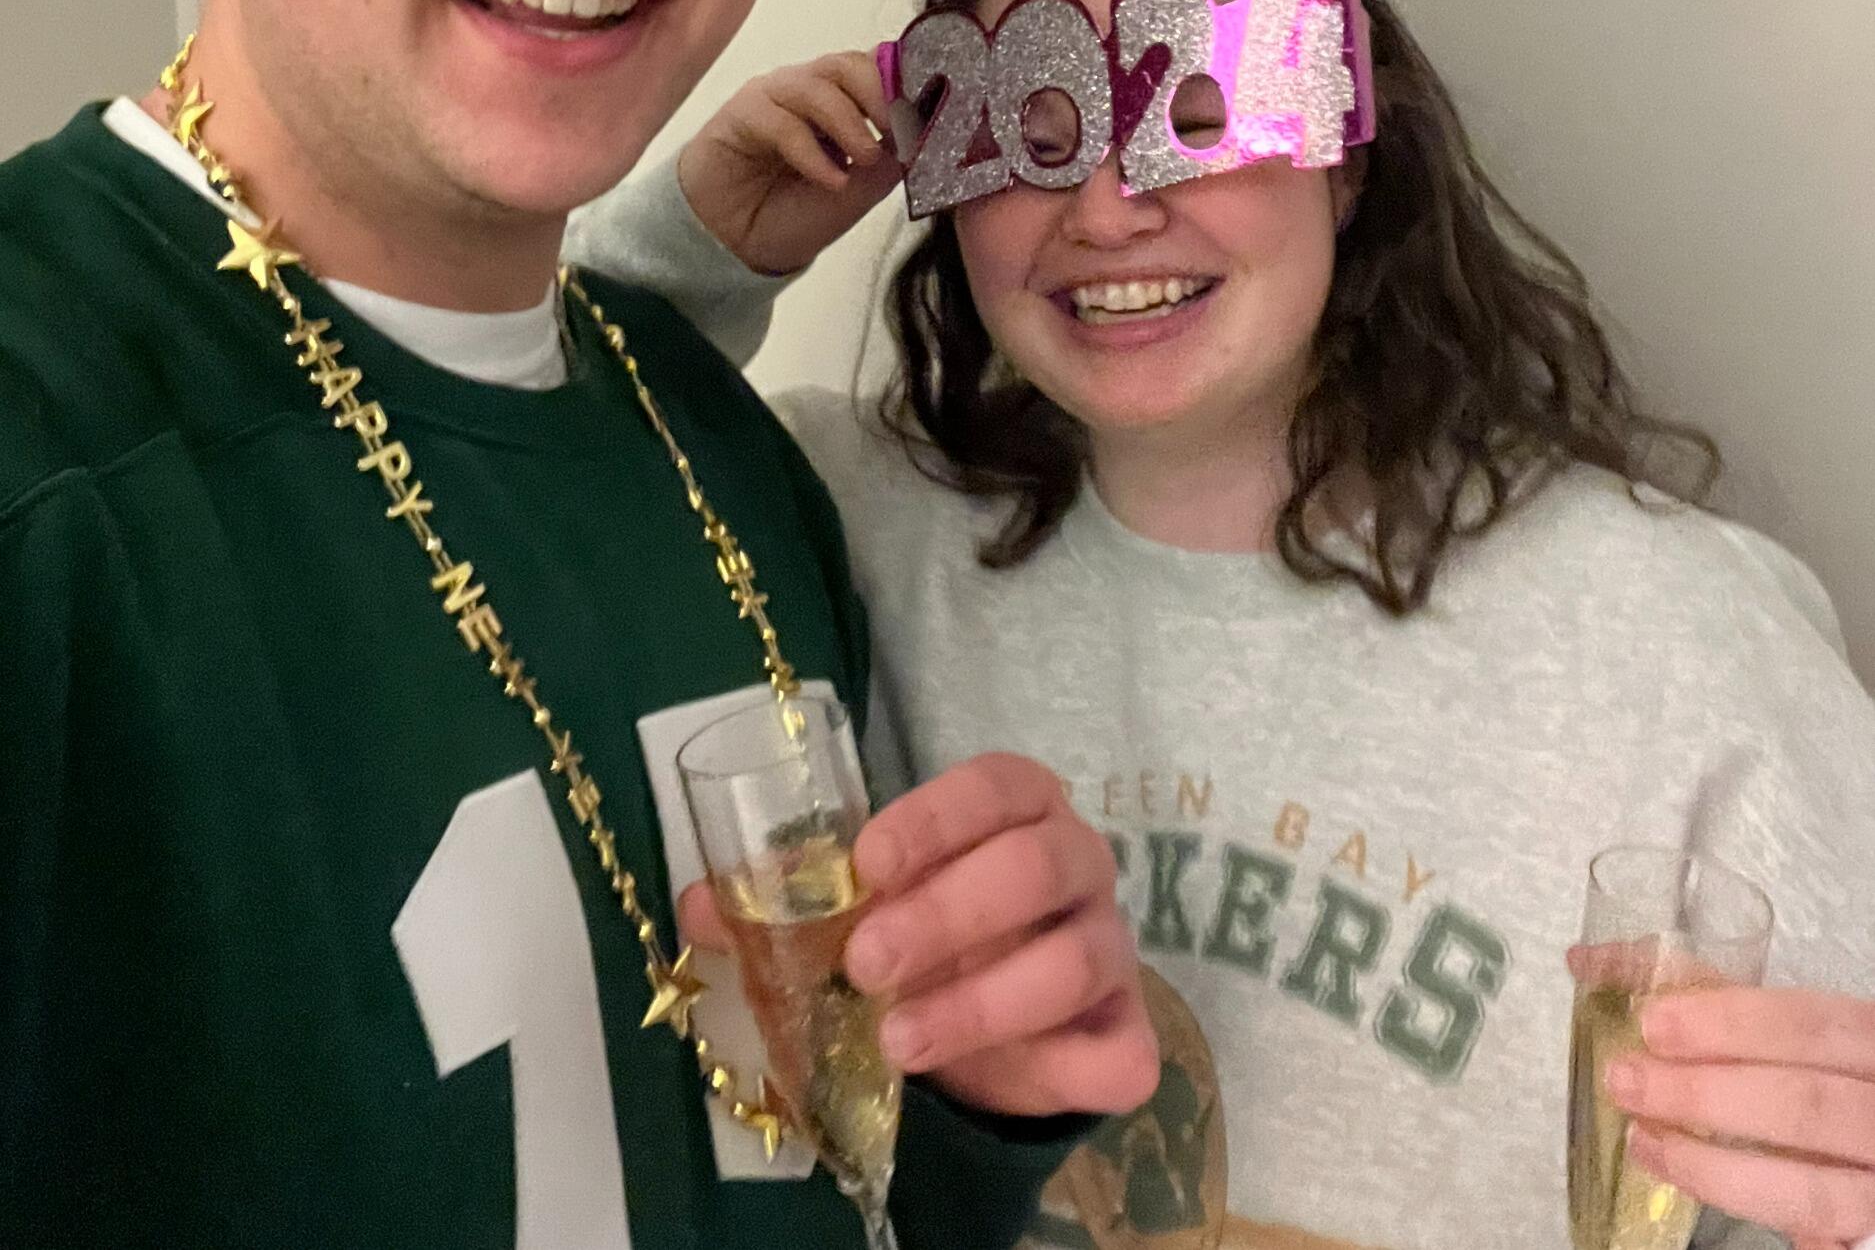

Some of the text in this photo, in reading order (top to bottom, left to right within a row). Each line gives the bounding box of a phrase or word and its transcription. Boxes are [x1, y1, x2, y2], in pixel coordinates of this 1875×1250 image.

[1061, 768, 1436, 903] EEN BAY
[1110, 830, 1514, 1086] KERS
